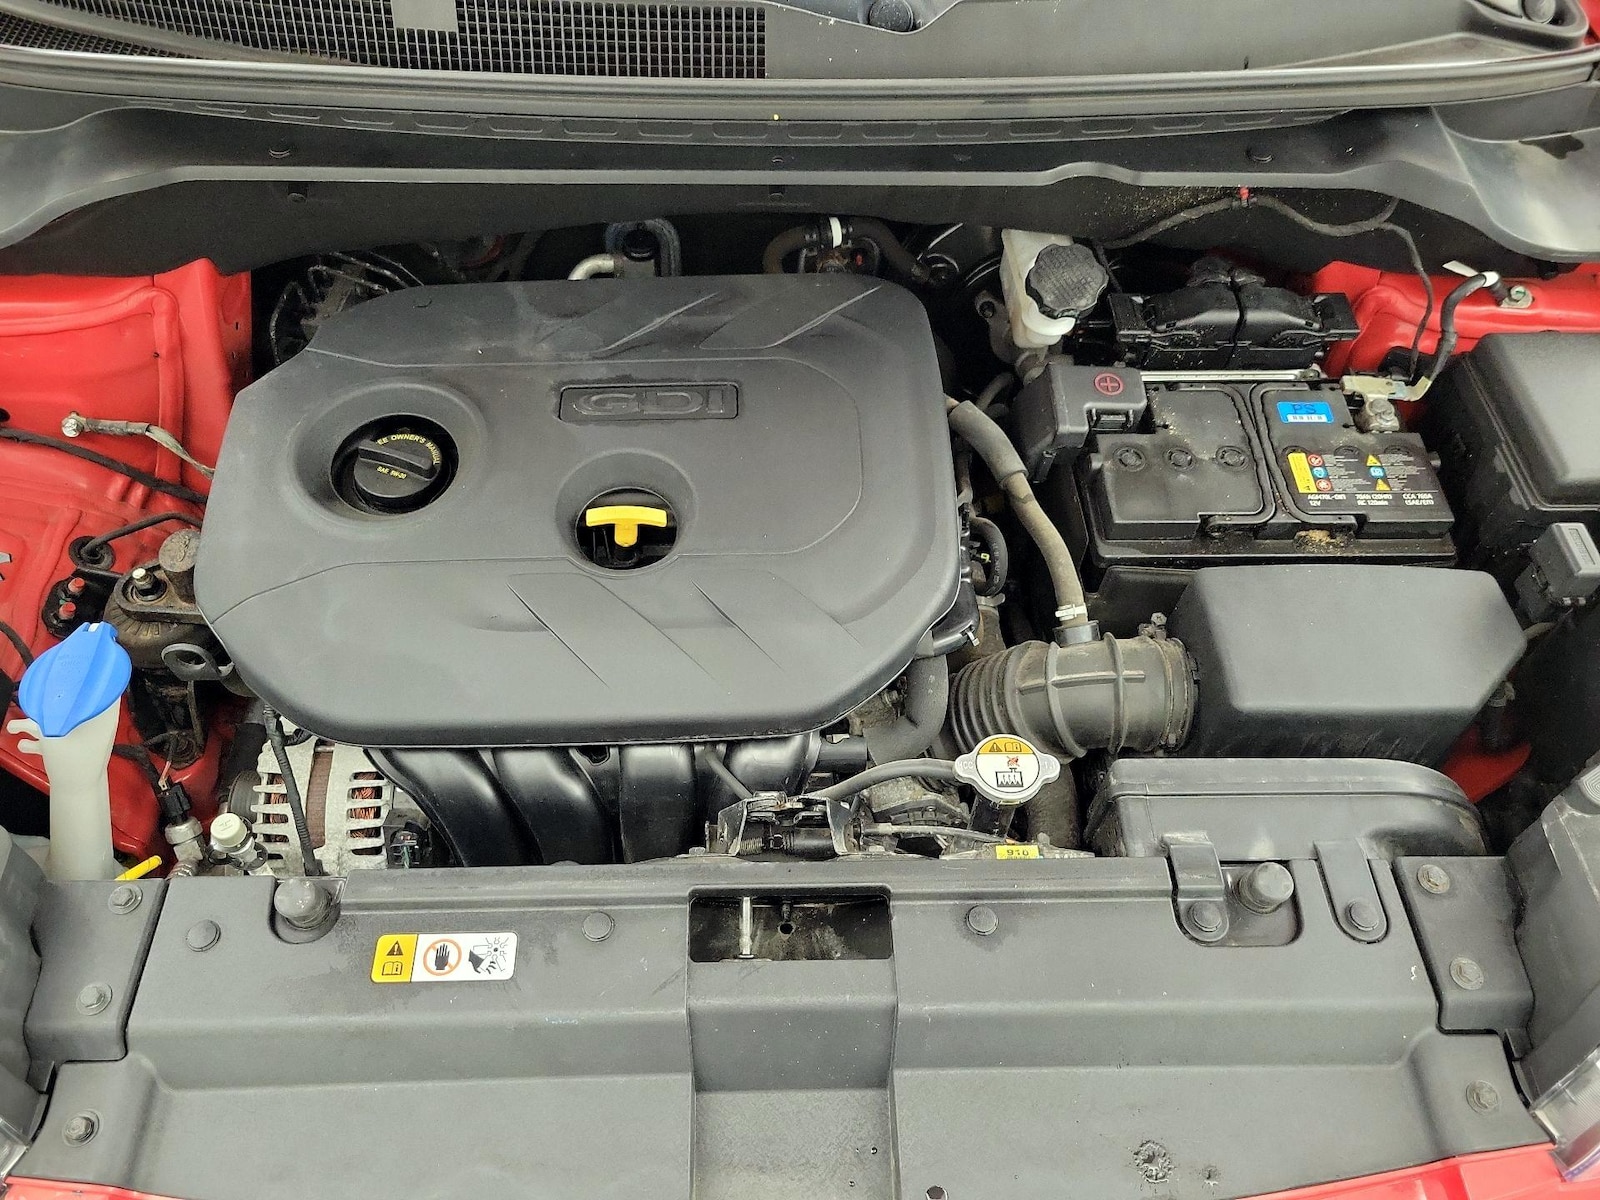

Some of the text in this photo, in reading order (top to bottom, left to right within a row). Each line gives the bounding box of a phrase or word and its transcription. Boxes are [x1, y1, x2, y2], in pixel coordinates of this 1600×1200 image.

[572, 388, 725, 416] GDI
[1292, 403, 1316, 414] PS
[391, 434, 426, 443] OWNER'S
